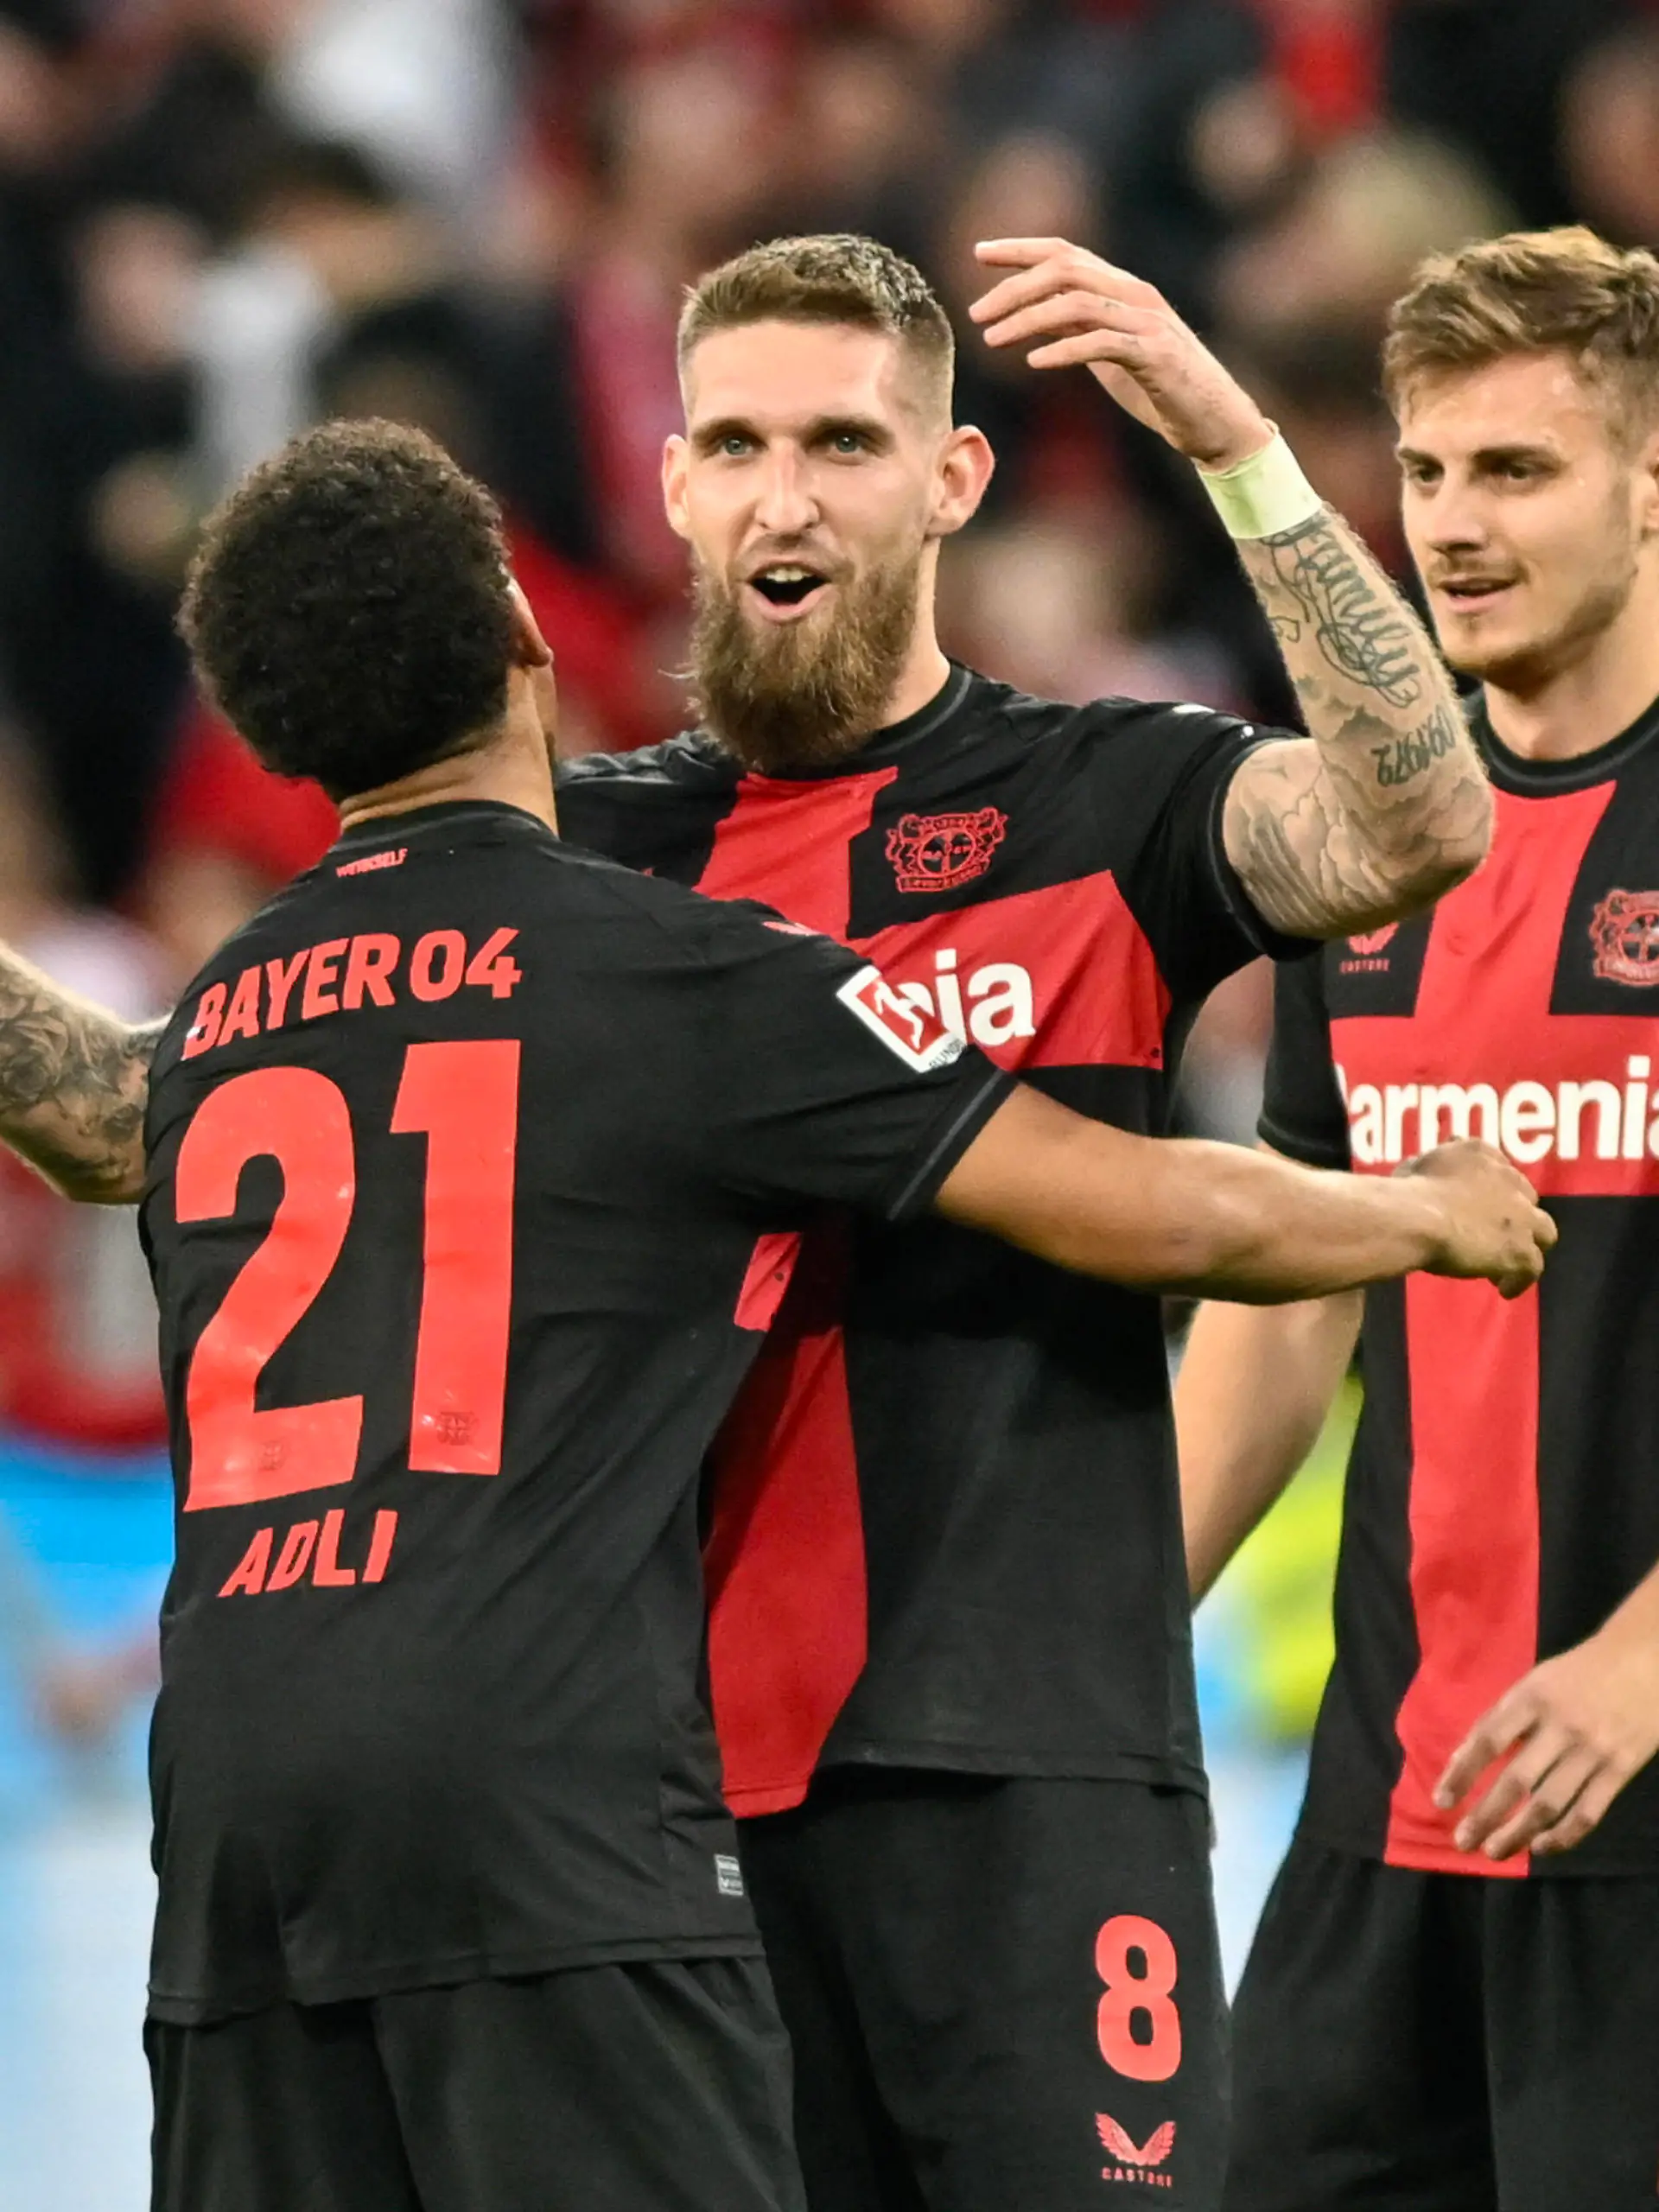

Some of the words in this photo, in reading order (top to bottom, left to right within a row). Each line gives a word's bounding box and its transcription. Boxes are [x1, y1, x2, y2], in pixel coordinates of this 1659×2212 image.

[181, 932, 401, 1060] BAYER
[409, 926, 524, 1002] 04
[1335, 1055, 1659, 1165] armeni
[174, 1039, 522, 1514] 21
[216, 1509, 399, 1599] ADLI
[1094, 1914, 1182, 2082] 8
